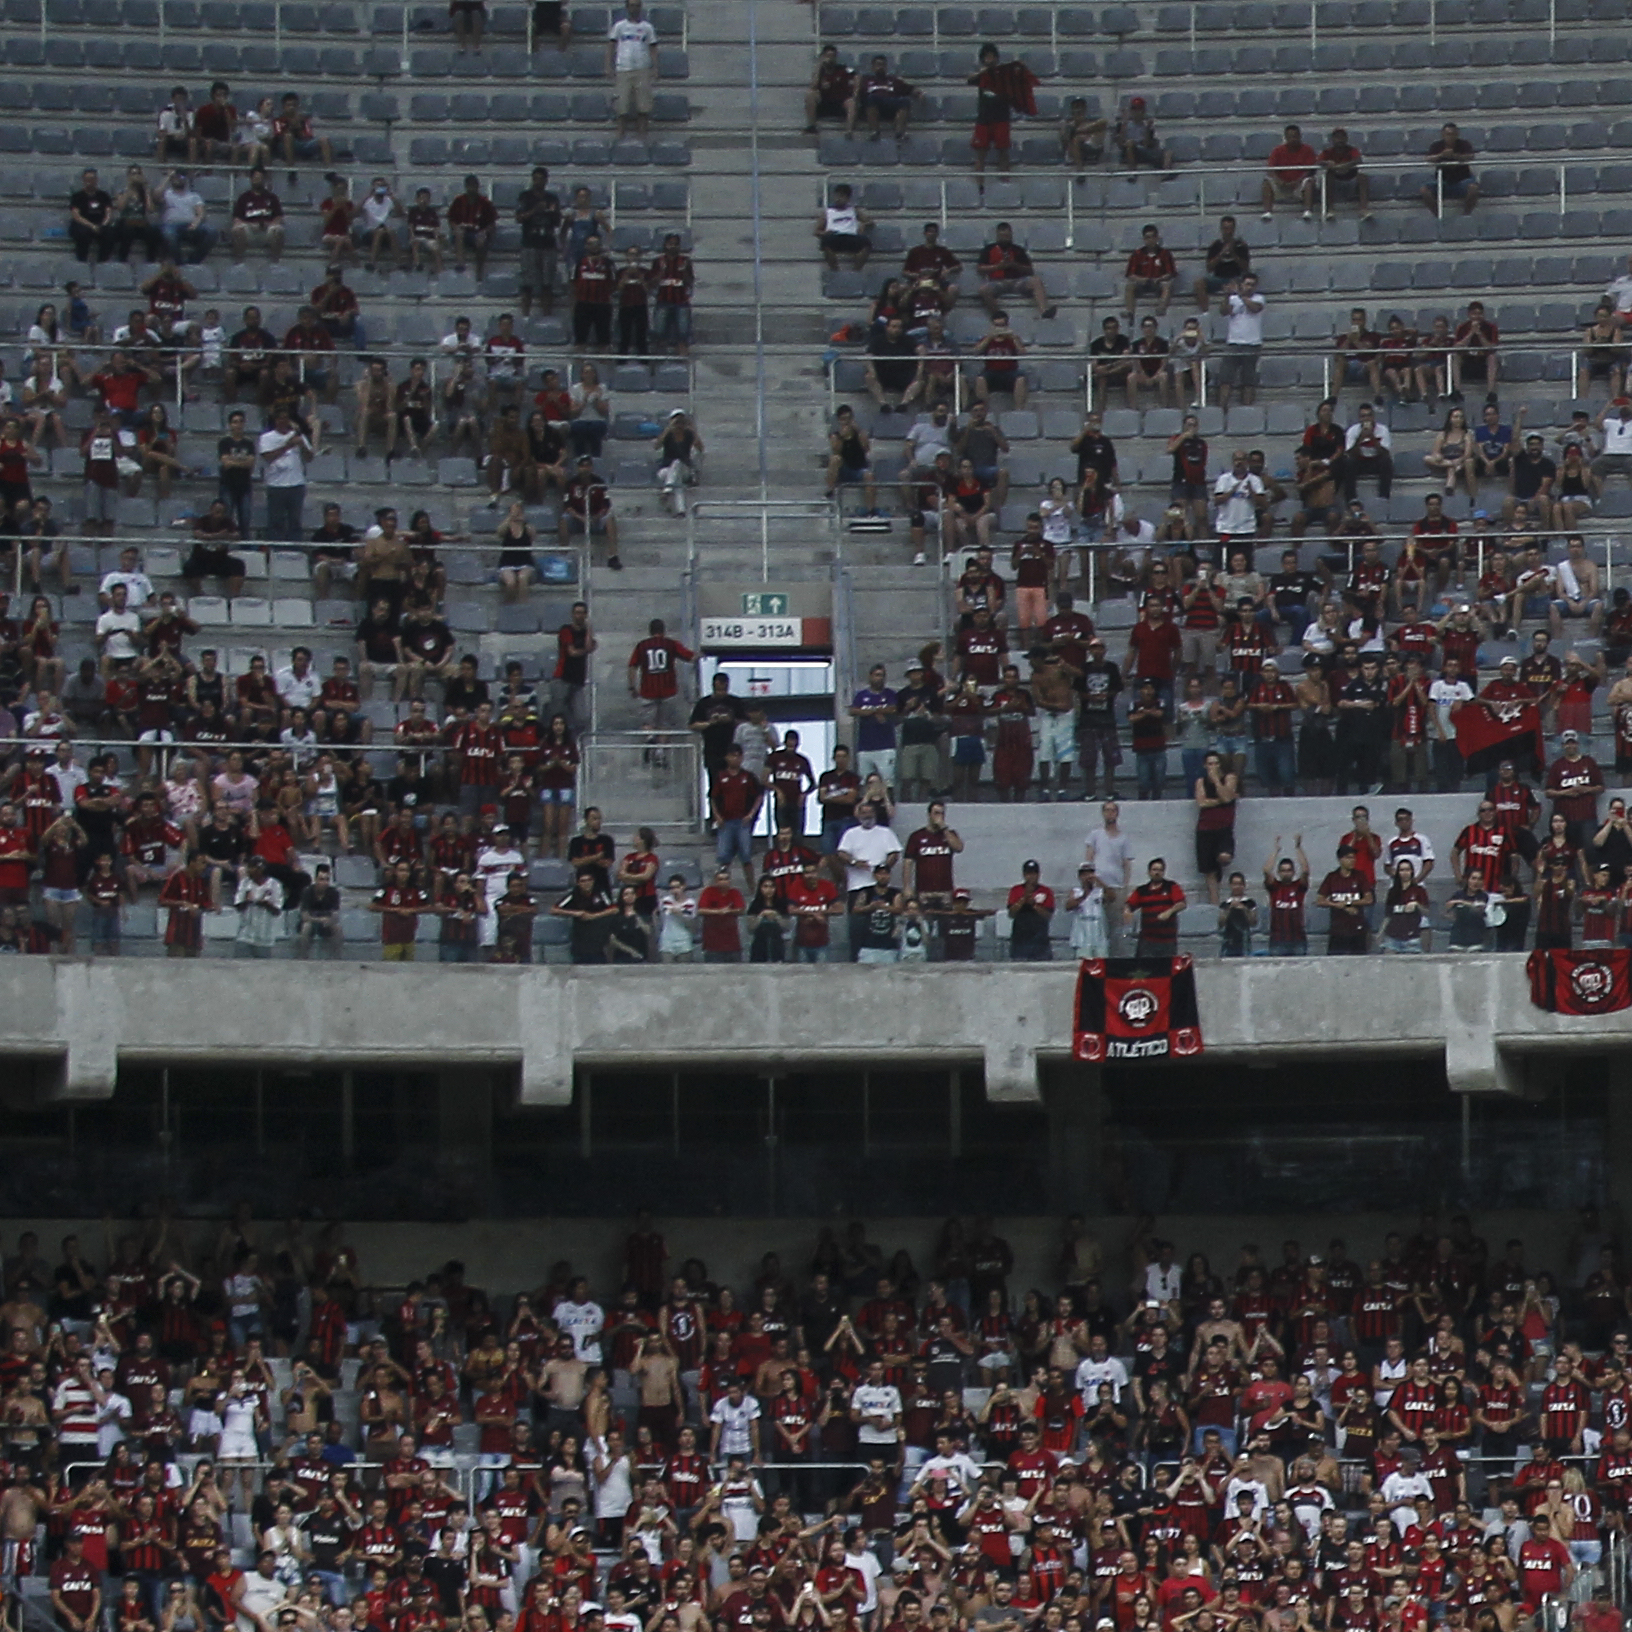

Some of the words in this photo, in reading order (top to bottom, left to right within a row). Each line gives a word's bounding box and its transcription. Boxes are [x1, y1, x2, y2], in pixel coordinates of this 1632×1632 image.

[705, 624, 742, 639] 314B
[757, 624, 794, 639] 313A
[647, 649, 667, 670] 10
[1405, 1402, 1435, 1411] CAIXA
